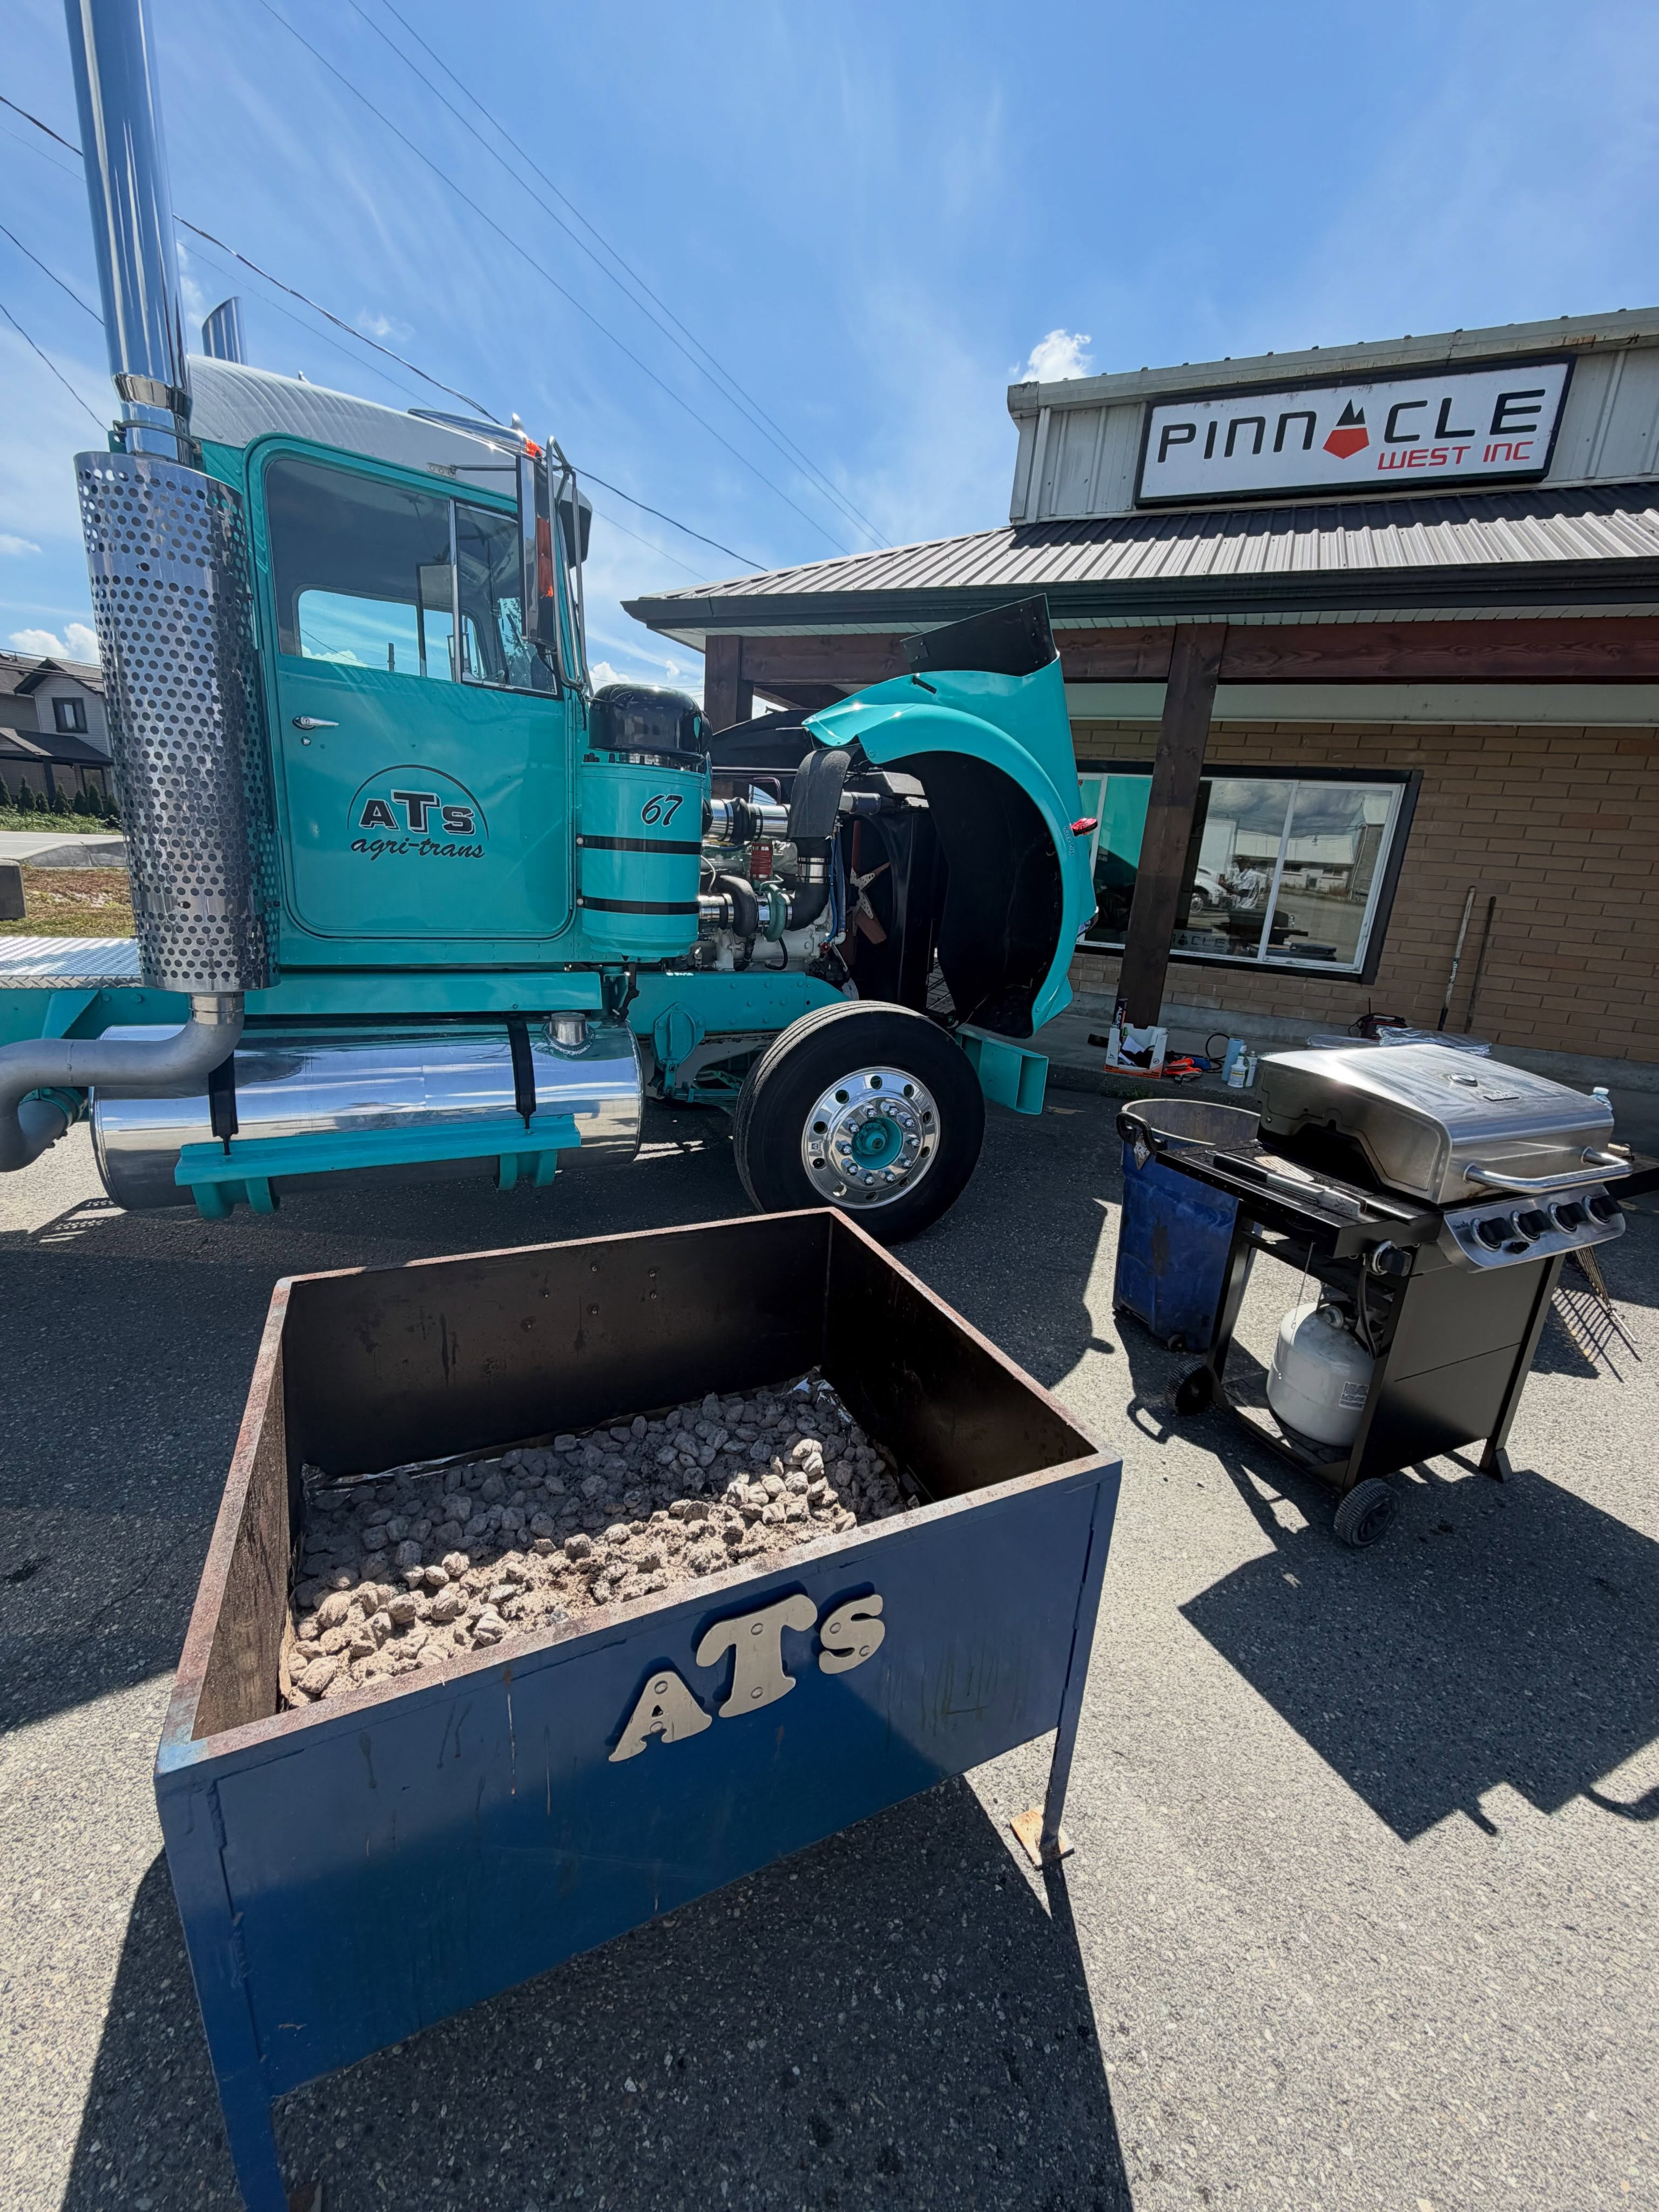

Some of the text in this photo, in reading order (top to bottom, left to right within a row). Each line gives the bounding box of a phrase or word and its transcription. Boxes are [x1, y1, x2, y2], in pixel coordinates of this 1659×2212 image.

[1378, 441, 1534, 471] WEST INC
[359, 789, 475, 835] ATS
[641, 794, 683, 827] 67
[350, 838, 485, 861] agri-trans
[608, 1594, 886, 1762] ATS
